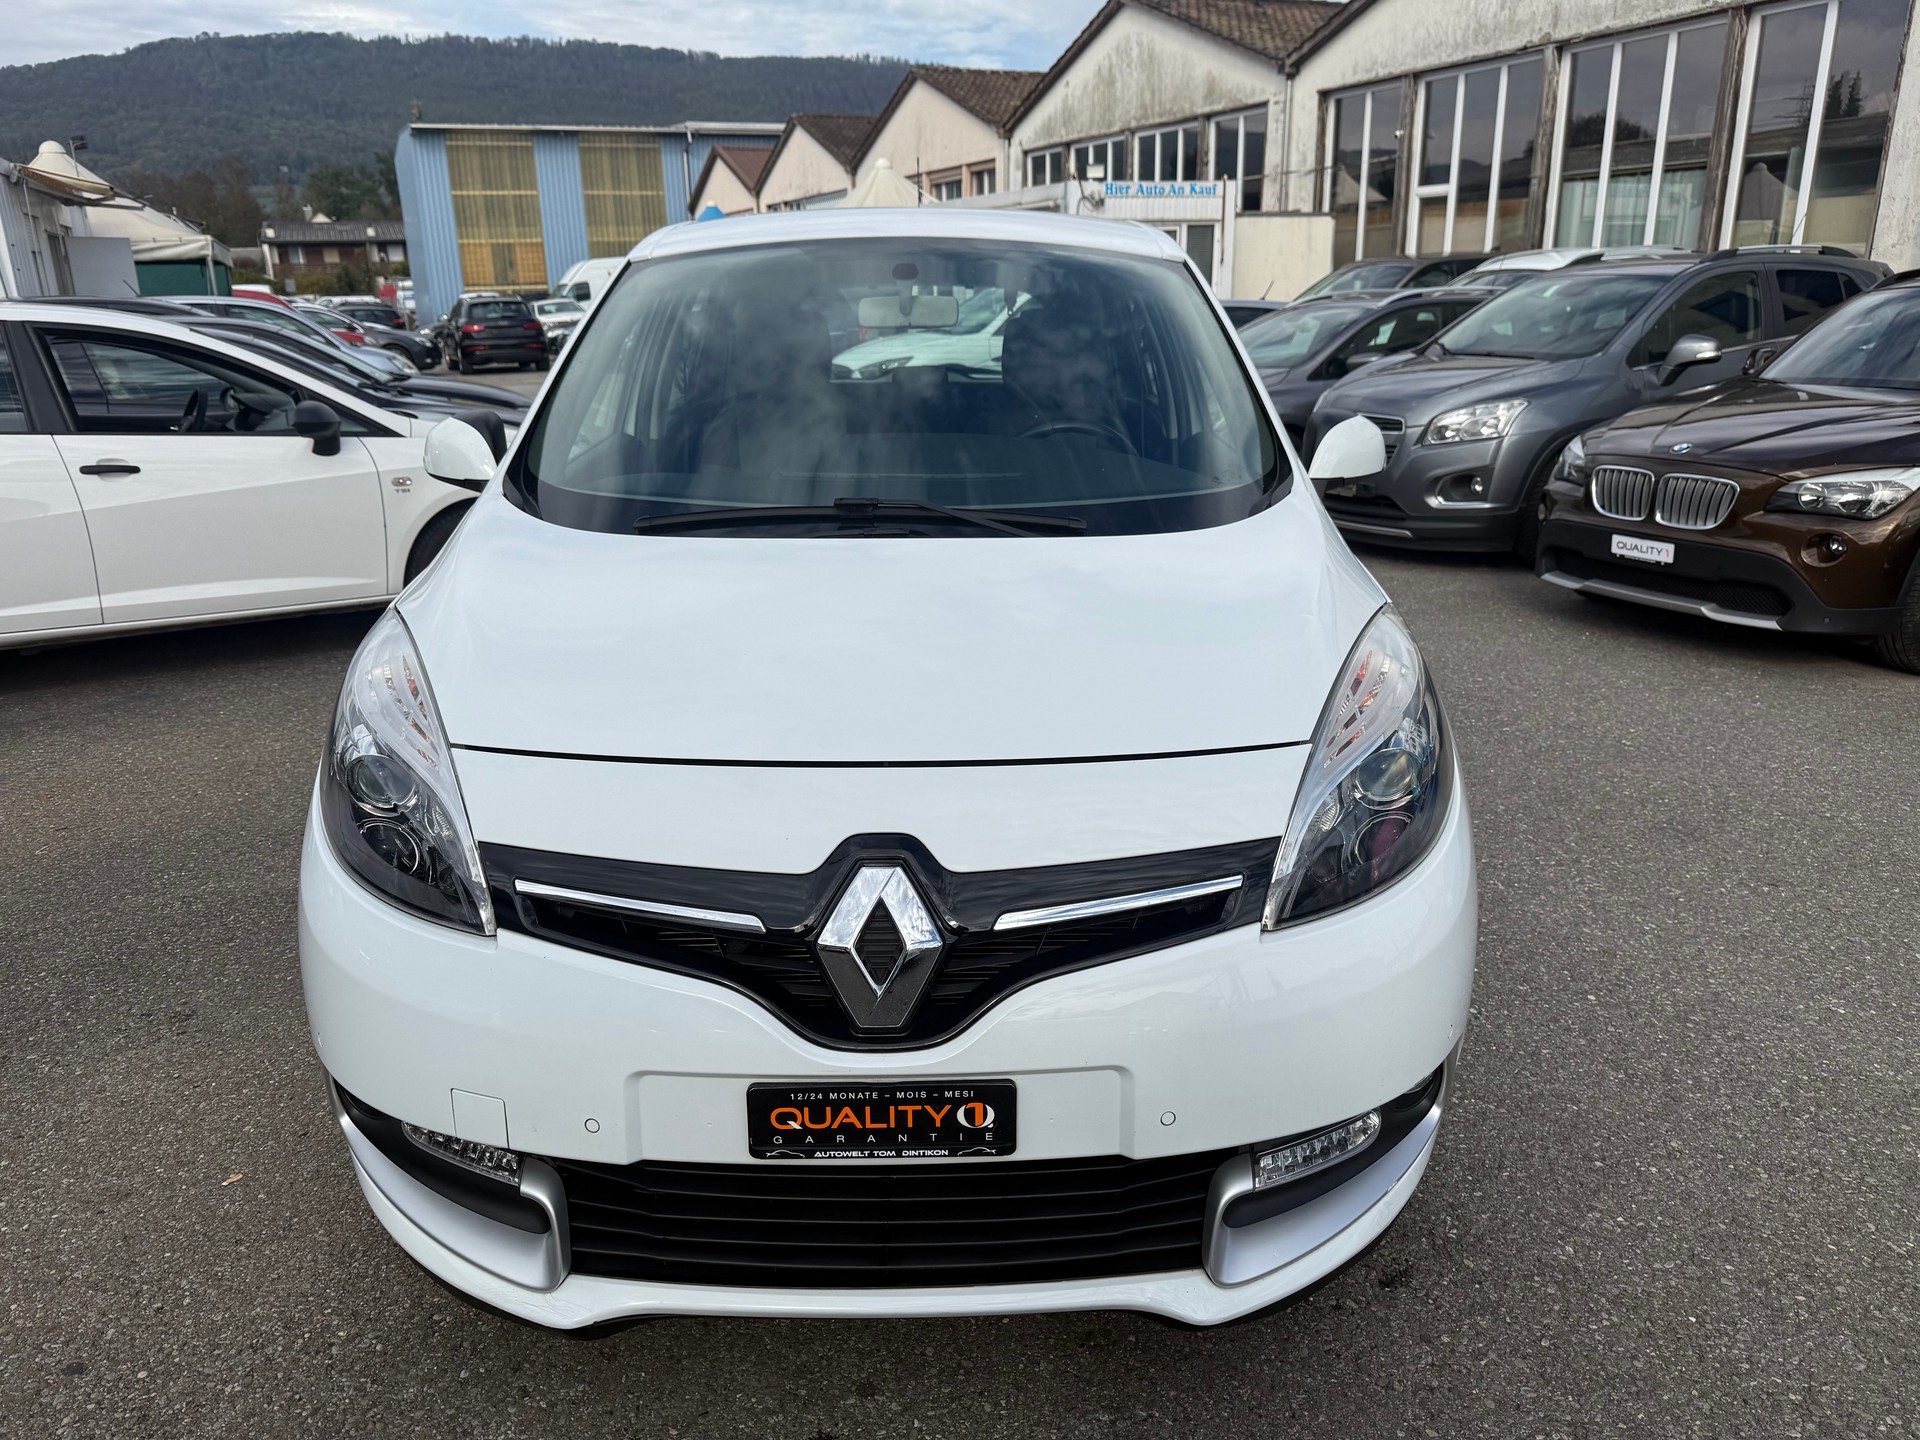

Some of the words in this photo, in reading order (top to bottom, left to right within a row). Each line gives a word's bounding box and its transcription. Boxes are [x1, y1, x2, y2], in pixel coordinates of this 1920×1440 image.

[1105, 183, 1131, 195] Hier
[1136, 183, 1165, 196] Auto
[1168, 183, 1184, 196] An
[1189, 183, 1217, 195] Kauf
[1616, 541, 1663, 556] QUALITY
[790, 1093, 823, 1101] 12/24
[829, 1091, 879, 1100] MONATE
[896, 1090, 928, 1099] MOIS
[944, 1090, 975, 1098] MESI
[770, 1104, 952, 1130] QUALITY
[773, 1132, 993, 1144] GARANTIE
